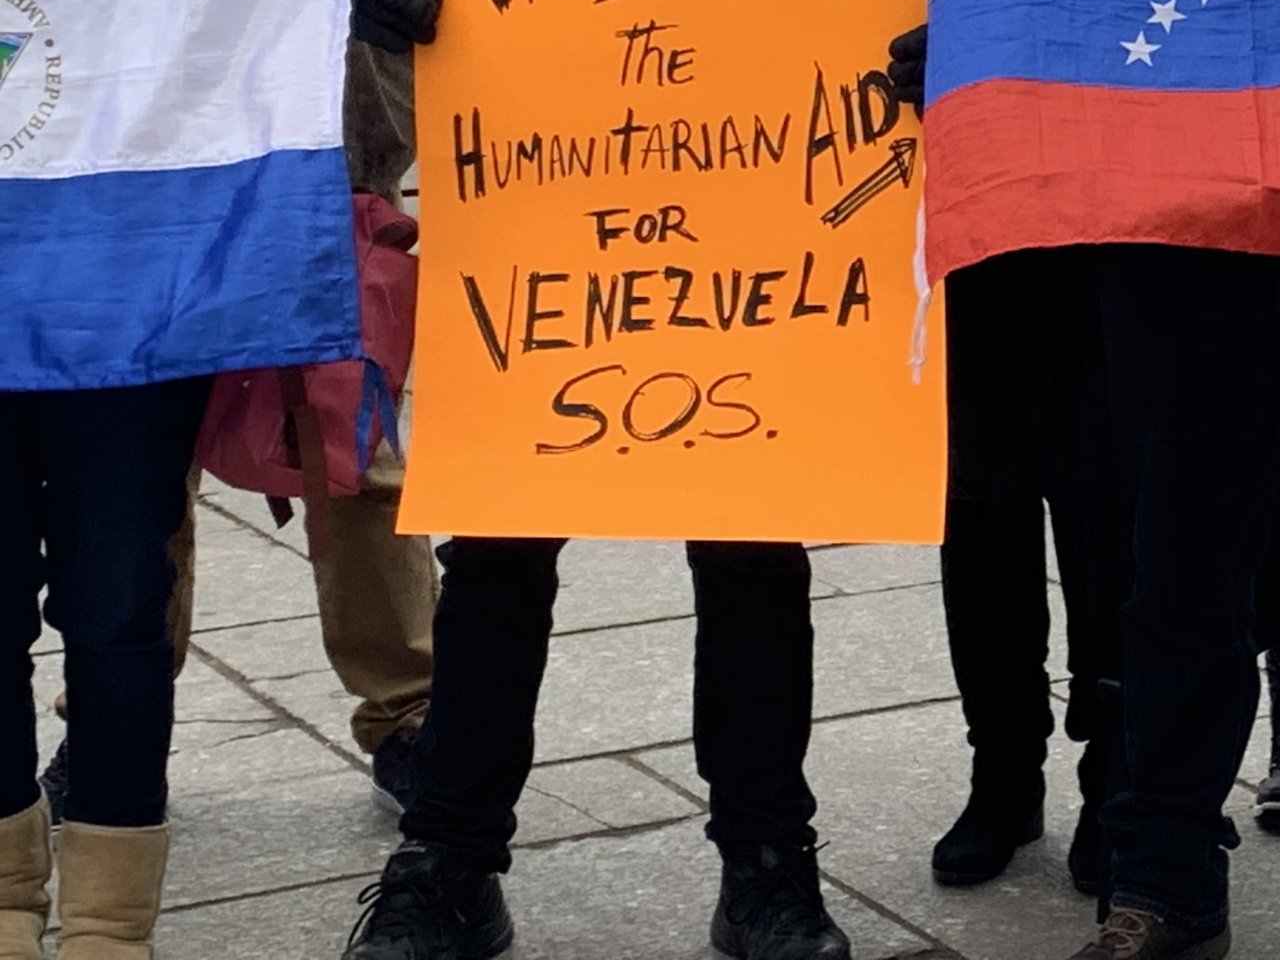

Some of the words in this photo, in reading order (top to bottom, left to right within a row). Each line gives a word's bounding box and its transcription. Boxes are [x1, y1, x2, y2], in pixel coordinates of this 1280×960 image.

[453, 106, 792, 203] HUMANITARIAN
[803, 60, 902, 205] AID
[585, 204, 700, 251] FOR
[459, 250, 871, 373] VENEZUELA
[535, 363, 779, 455] S.O.S.
